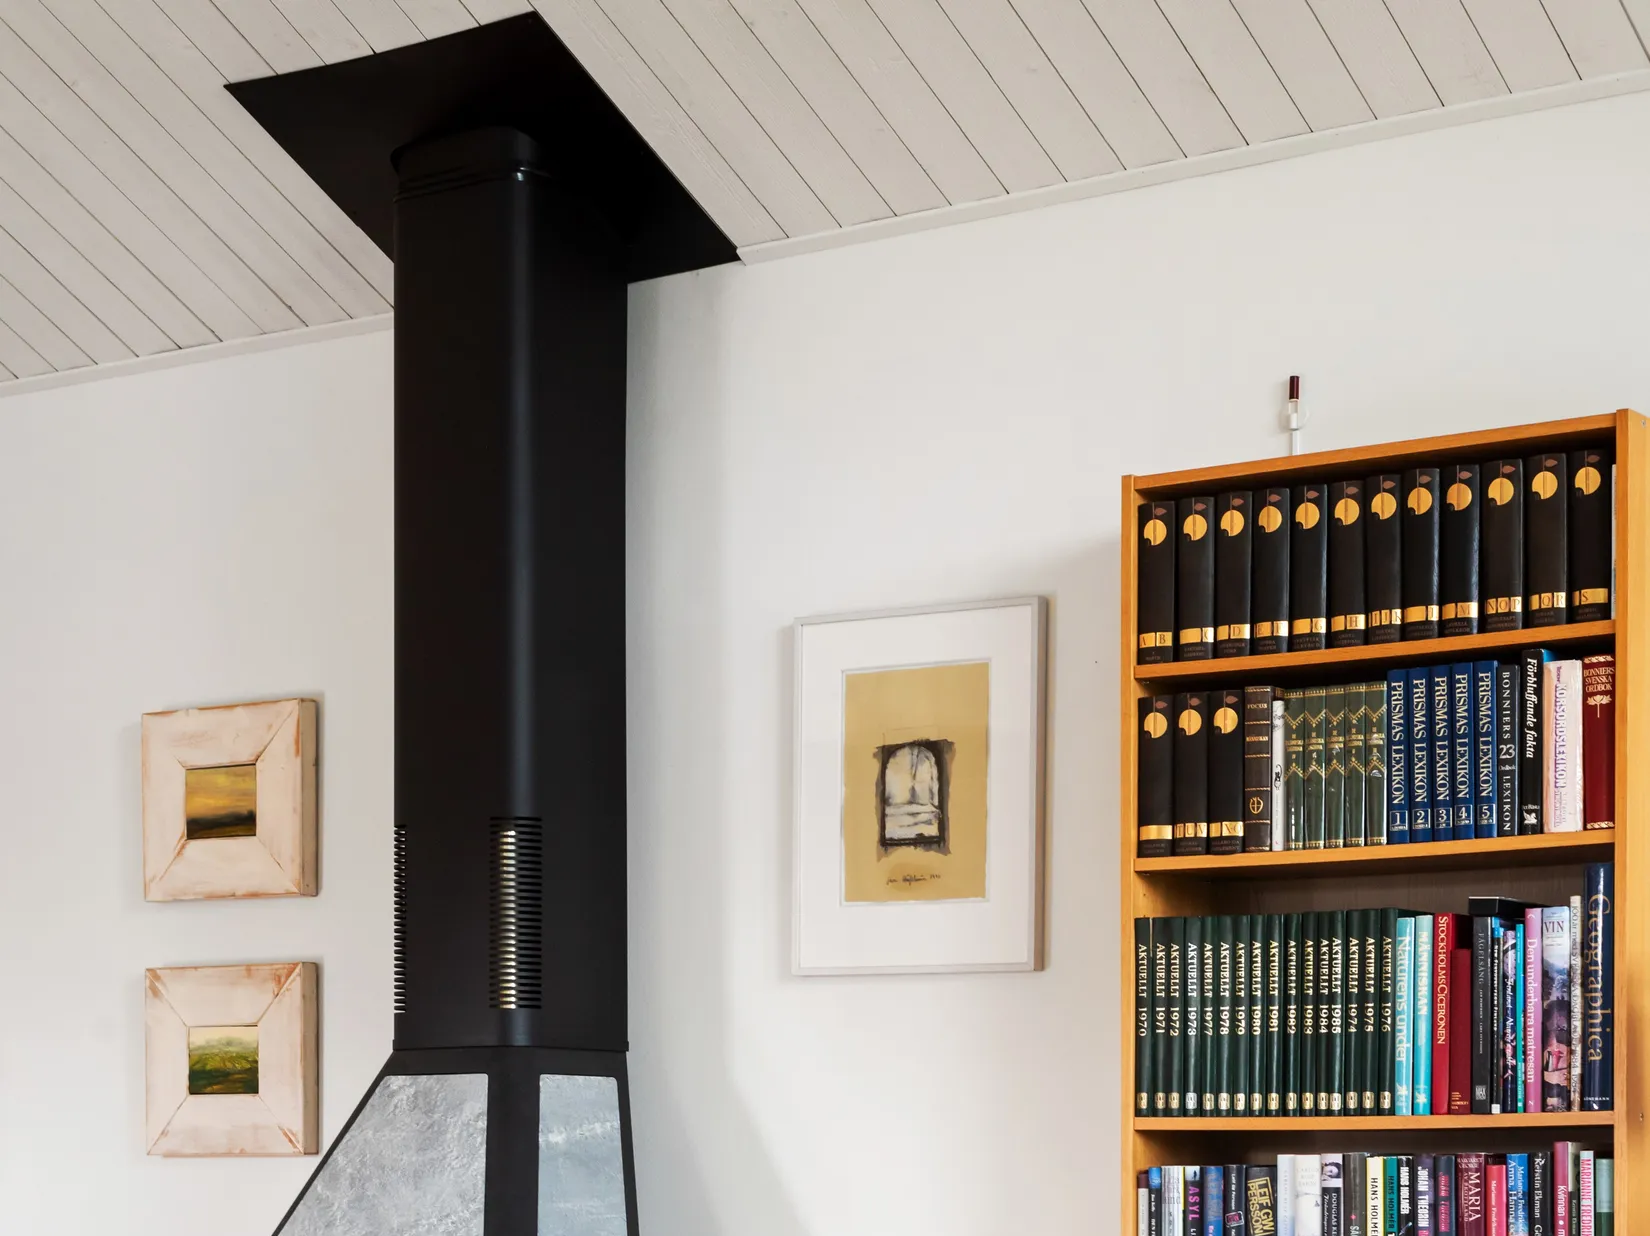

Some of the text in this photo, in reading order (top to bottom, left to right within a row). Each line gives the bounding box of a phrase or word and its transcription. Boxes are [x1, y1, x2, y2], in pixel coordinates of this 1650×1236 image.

[1502, 672, 1511, 739] BONNIERS
[1584, 667, 1615, 677] BONNIERS
[1585, 675, 1612, 685] SVENSKA
[1585, 683, 1612, 692] ORDBOK
[1413, 679, 1427, 802] PRISMAS LEXIKON
[1435, 676, 1449, 801] PRISMAS LEXIKON
[1455, 673, 1469, 798] PRISMAS LEXIKON
[1478, 672, 1492, 797] PRISMAS LEXIKON
[1525, 658, 1537, 758] Förbluffande fakta
[1555, 683, 1567, 789] KORSORDSLEXIKON
[1391, 681, 1404, 804] PRISMAS LEXIKON
[1500, 744, 1515, 759] 23
[1395, 812, 1401, 825] 1
[1416, 810, 1425, 823] 2
[1439, 809, 1447, 822] 3
[1459, 807, 1467, 819] 4
[1482, 805, 1490, 819] 5
[1503, 776, 1511, 830] LEXIKON
[1478, 933, 1486, 985] FÅGELSÅNG
[1544, 921, 1564, 933] VIN
[1138, 943, 1148, 1037] AKTUELLT 1970
[1156, 943, 1165, 1034] AKTUELLT 1971
[1170, 943, 1179, 1037] AKTUELLT 1972
[1187, 942, 1197, 1036] AKTUELLT 1973
[1204, 943, 1213, 1036] AKTUELLT 1977
[1220, 942, 1229, 1035] AKTUELLT 1978
[1235, 942, 1245, 1035] AKTUELLT 1979
[1251, 941, 1261, 1035] AKTUELLT 1980
[1269, 940, 1279, 1032] AKTUELLT 1981
[1287, 940, 1296, 1034] AKTUELLT 1982
[1304, 939, 1313, 996] AKTUELLT
[1319, 938, 1329, 1034] AKTUELLT 1984
[1331, 937, 1341, 1034] AKTUELLT 1985
[1348, 937, 1359, 1033] AKTUELLT 1974
[1364, 936, 1375, 1032] AKTUELLT 1975
[1382, 936, 1392, 1032] AKTUELLT 1976
[1396, 936, 1411, 1062] Naturens under
[1418, 932, 1428, 1015] MÄNNISKAN
[1584, 895, 1611, 1062] Geographica
[1527, 939, 1537, 1082] Den underbara matresan
[1189, 1186, 1199, 1221] ASYL
[1256, 1180, 1275, 1230] LEIF GW
[1400, 1166, 1409, 1185] HANS
[1418, 1166, 1430, 1228] JOHAN THEORIN
[1468, 1171, 1481, 1222] MARIA
[1507, 1160, 1516, 1187] Anna,
[1508, 1191, 1517, 1222] Hanna
[1517, 1166, 1525, 1197] Marianne
[1534, 1158, 1543, 1188] Kerstin
[1534, 1190, 1542, 1218] Ekman
[1558, 1185, 1567, 1216] Kvinnan
[1581, 1158, 1592, 1202] MARIANNE
[1248, 1183, 1264, 1234] PERSSON
